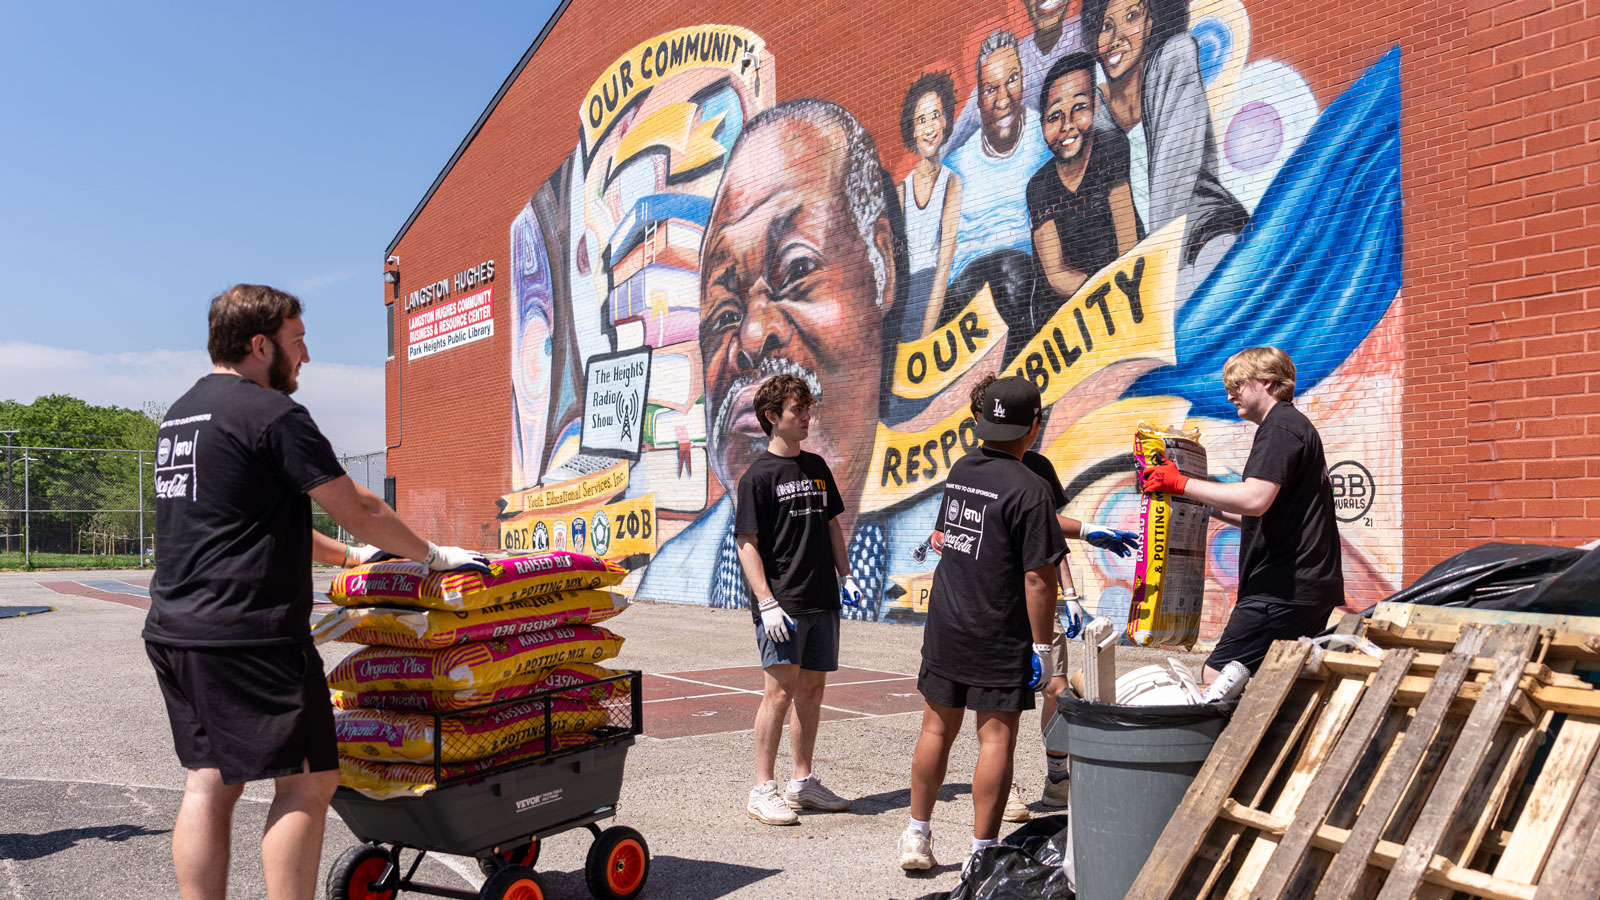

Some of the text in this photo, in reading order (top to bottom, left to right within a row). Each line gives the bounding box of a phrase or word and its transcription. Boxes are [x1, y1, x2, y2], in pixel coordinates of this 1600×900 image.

[589, 32, 755, 128] OUR COMMUNITY
[404, 260, 495, 311] LANGSTON HUGHES
[408, 288, 492, 330] LANGSTON HUGHES COMMUNITY
[409, 304, 491, 343] BUSINESS & RESOURCE CENTER
[410, 324, 491, 357] Park Heights Public Library
[907, 312, 989, 384] OUR
[595, 369, 611, 385] The
[593, 390, 617, 407] Radio
[993, 398, 1006, 418] LA
[592, 413, 613, 429] Show
[527, 496, 545, 509] Youth
[546, 487, 582, 506] Educational
[613, 472, 626, 488] Inc.
[1330, 474, 1366, 497] BB
[1334, 498, 1366, 509] MURALS
[964, 508, 981, 523] BTU
[1136, 518, 1147, 562] RAISED
[1153, 506, 1165, 561] POTTING
[514, 557, 554, 574] RAISED
[1154, 565, 1162, 573] &
[350, 575, 415, 595] Organic Plus
[520, 580, 563, 598] POTTING
[564, 577, 584, 588] MIX
[493, 624, 517, 637] BED
[518, 627, 576, 647] RAISED BED
[567, 647, 586, 660] MIX
[360, 657, 426, 679] Organic Plus
[336, 721, 378, 742] Organic
[516, 795, 541, 808] VEVOR
